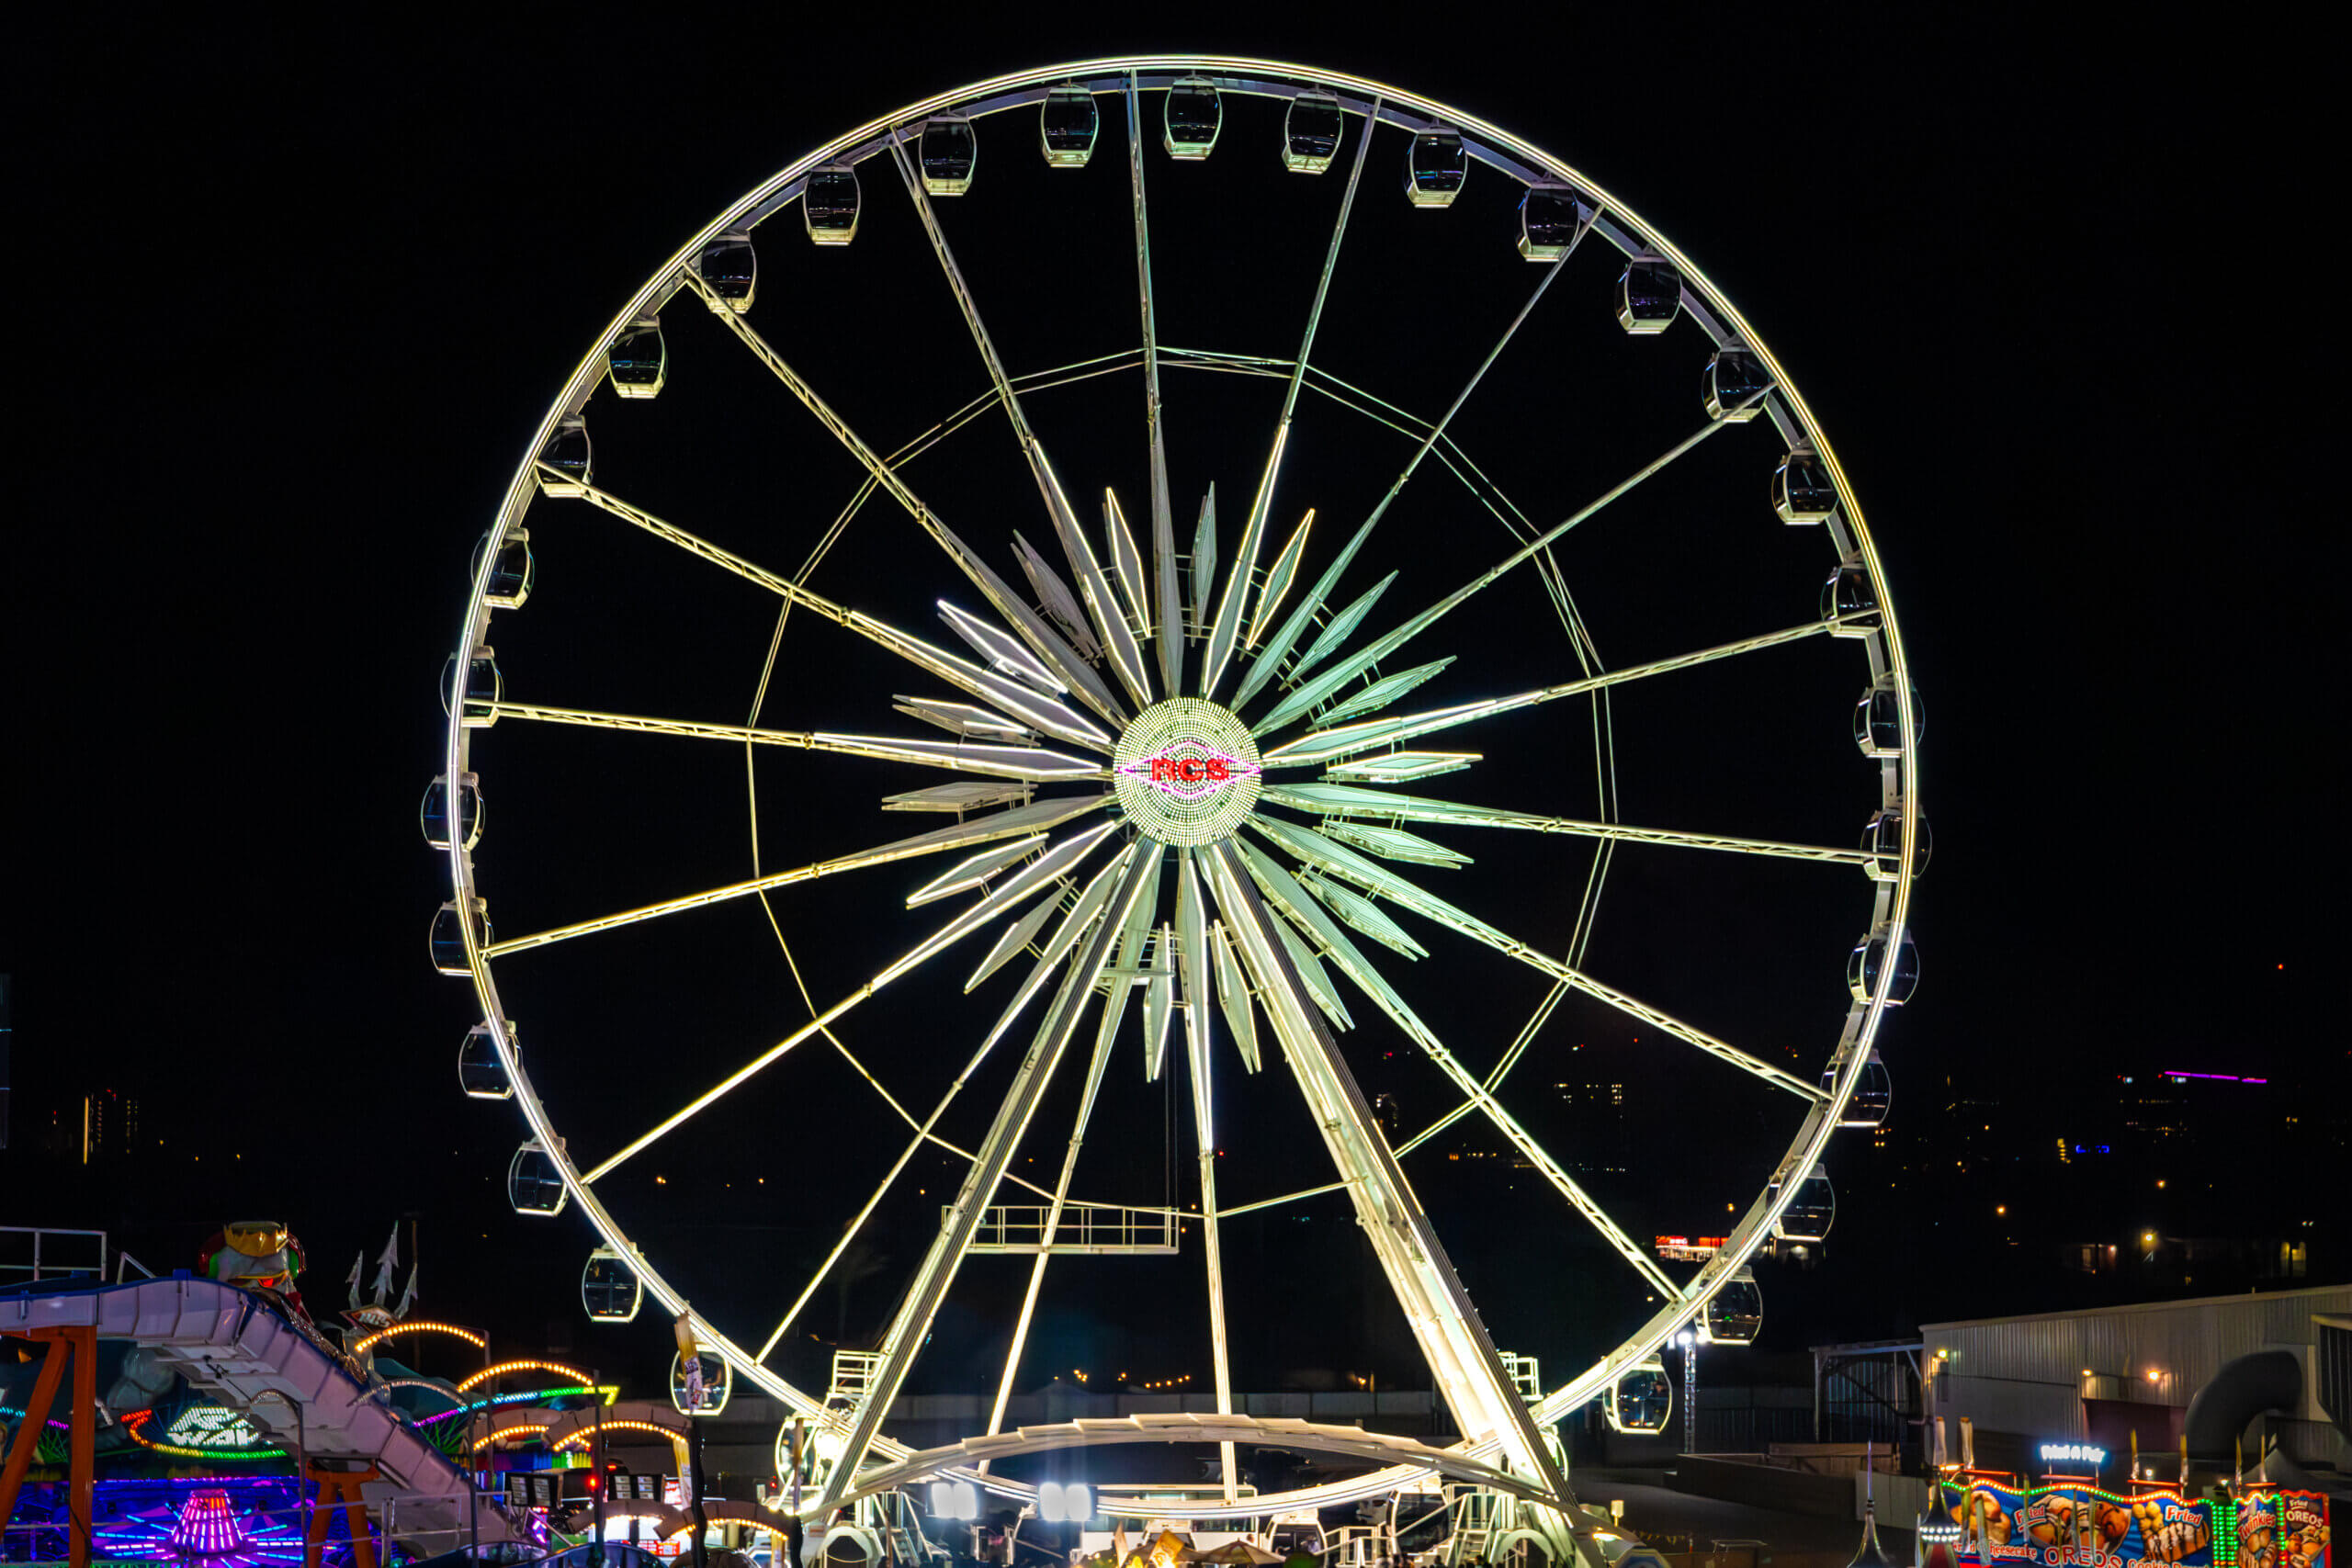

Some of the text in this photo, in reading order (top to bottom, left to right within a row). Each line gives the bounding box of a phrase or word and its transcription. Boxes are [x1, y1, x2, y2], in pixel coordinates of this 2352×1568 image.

[1151, 759, 1229, 782] RCS
[2165, 1505, 2203, 1528] Fried
[2286, 1509, 2324, 1529] OREOS
[1977, 1540, 2038, 1561] heesecake
